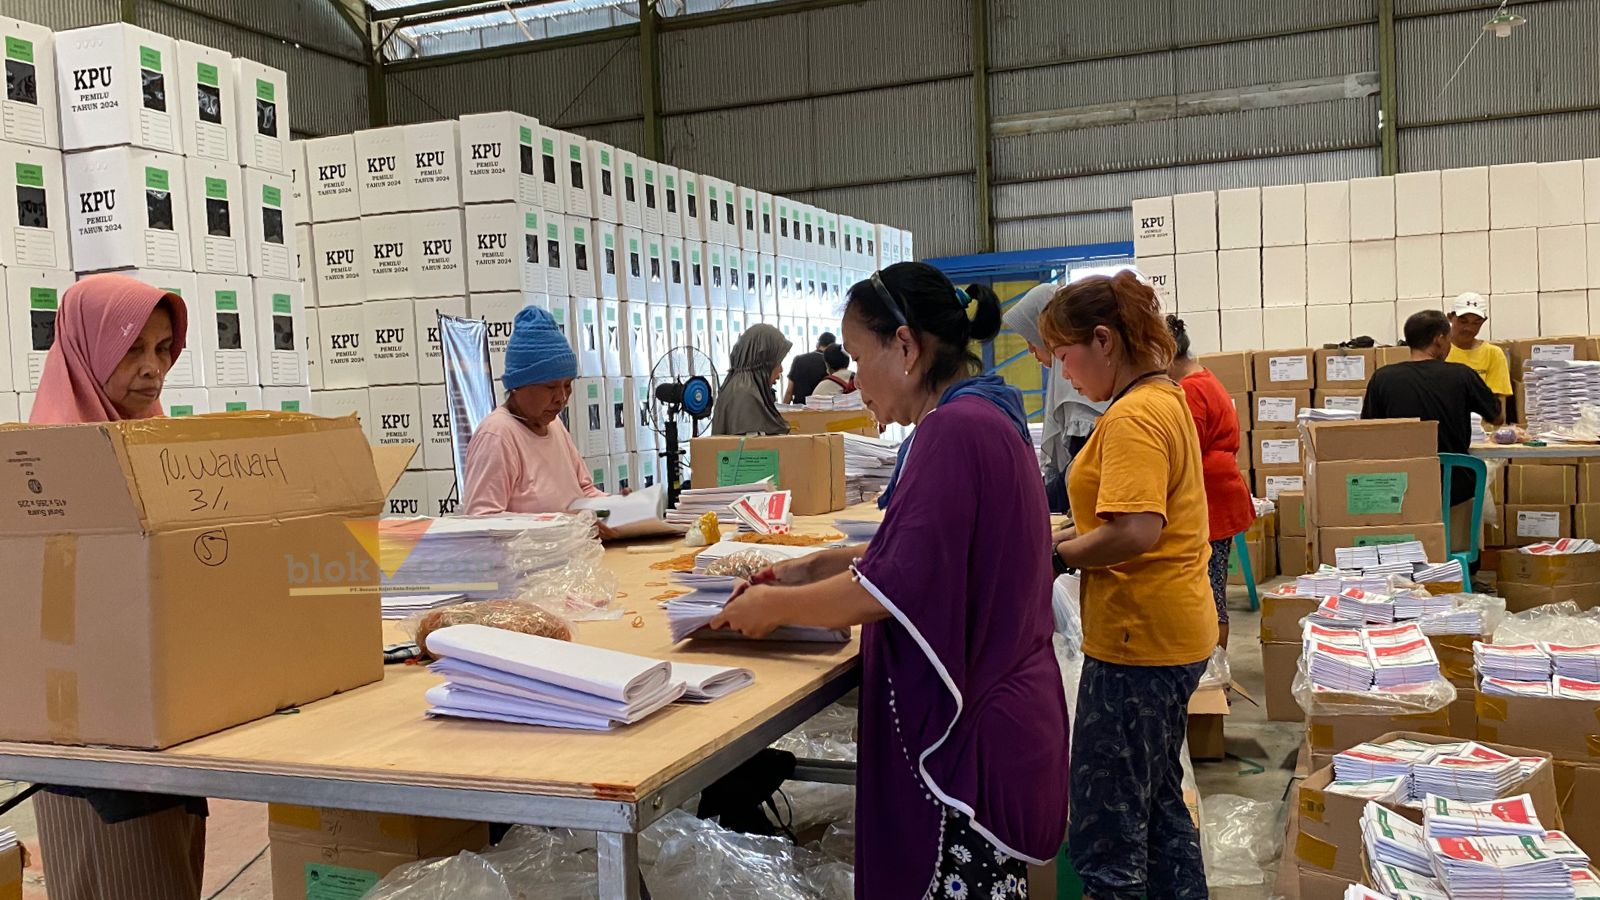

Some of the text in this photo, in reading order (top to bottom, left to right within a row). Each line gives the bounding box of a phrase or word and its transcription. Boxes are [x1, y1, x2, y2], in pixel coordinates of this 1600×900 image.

[73, 66, 112, 91] KPU
[80, 92, 110, 102] PEMILU
[71, 100, 119, 112] TAHUN 2024
[415, 151, 445, 168] KPU
[471, 143, 502, 160] KPU
[318, 164, 347, 181] KPU
[367, 156, 396, 173] KPU
[79, 189, 116, 214] KPU
[86, 215, 113, 225] PEMILU
[1141, 216, 1164, 228] KPU
[78, 224, 122, 235] TAHUN 2024
[423, 239, 453, 256] KPU
[477, 233, 507, 249] KPU
[326, 249, 355, 265] KPU
[374, 243, 404, 259] KPU
[1149, 275, 1167, 286] PU
[331, 333, 360, 349] KPU
[376, 328, 404, 344] KPU
[381, 414, 411, 429] KPU
[432, 413, 450, 429] KP
[390, 499, 418, 514] KPU
[438, 499, 457, 514] KP
